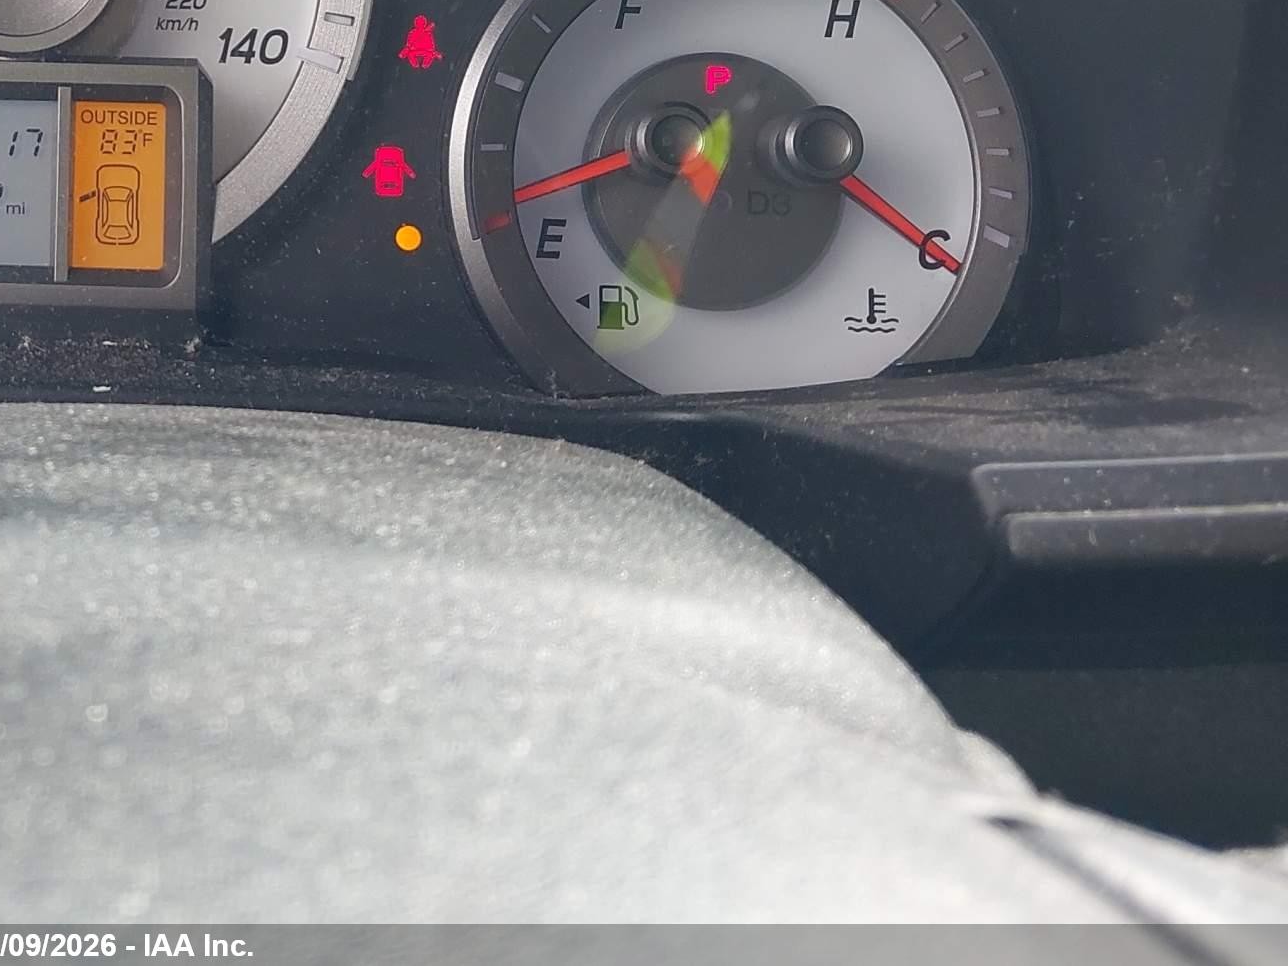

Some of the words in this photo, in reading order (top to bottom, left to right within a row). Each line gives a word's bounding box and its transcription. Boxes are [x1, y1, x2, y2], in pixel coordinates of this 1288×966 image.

[156, 16, 199, 31] km/h
[824, 0, 861, 38] H
[219, 28, 288, 65] 140
[706, 66, 731, 94] P
[80, 109, 158, 126] OUTSIDE
[6, 202, 26, 215] mi
[535, 219, 567, 260] E
[919, 229, 952, 270] C
